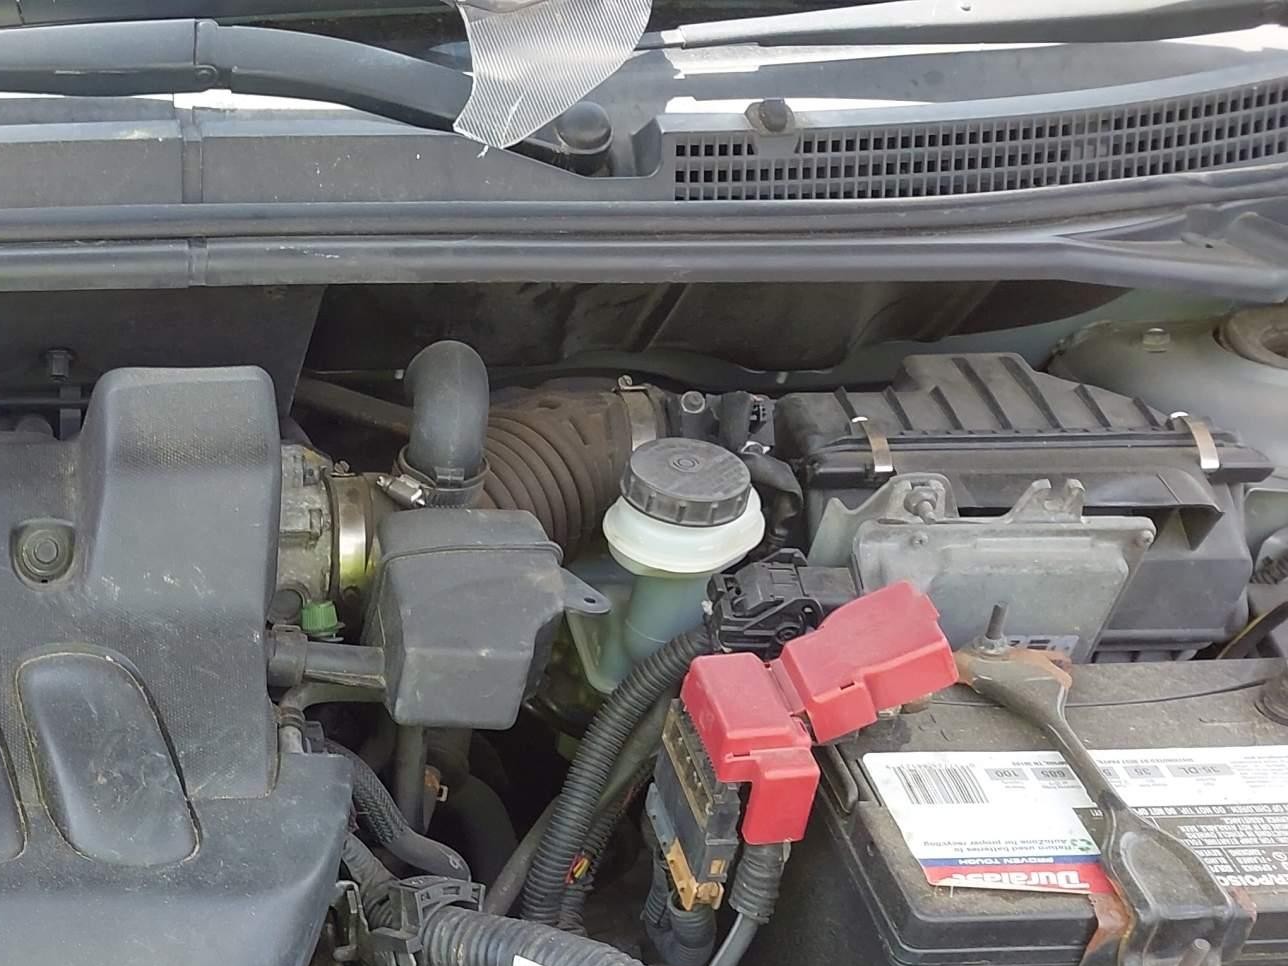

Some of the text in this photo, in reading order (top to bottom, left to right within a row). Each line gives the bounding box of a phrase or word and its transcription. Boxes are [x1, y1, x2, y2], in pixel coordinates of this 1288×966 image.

[995, 769, 1018, 778] 100
[958, 857, 1054, 866] PROVEN TOUGH
[951, 871, 1091, 889] Duralast
